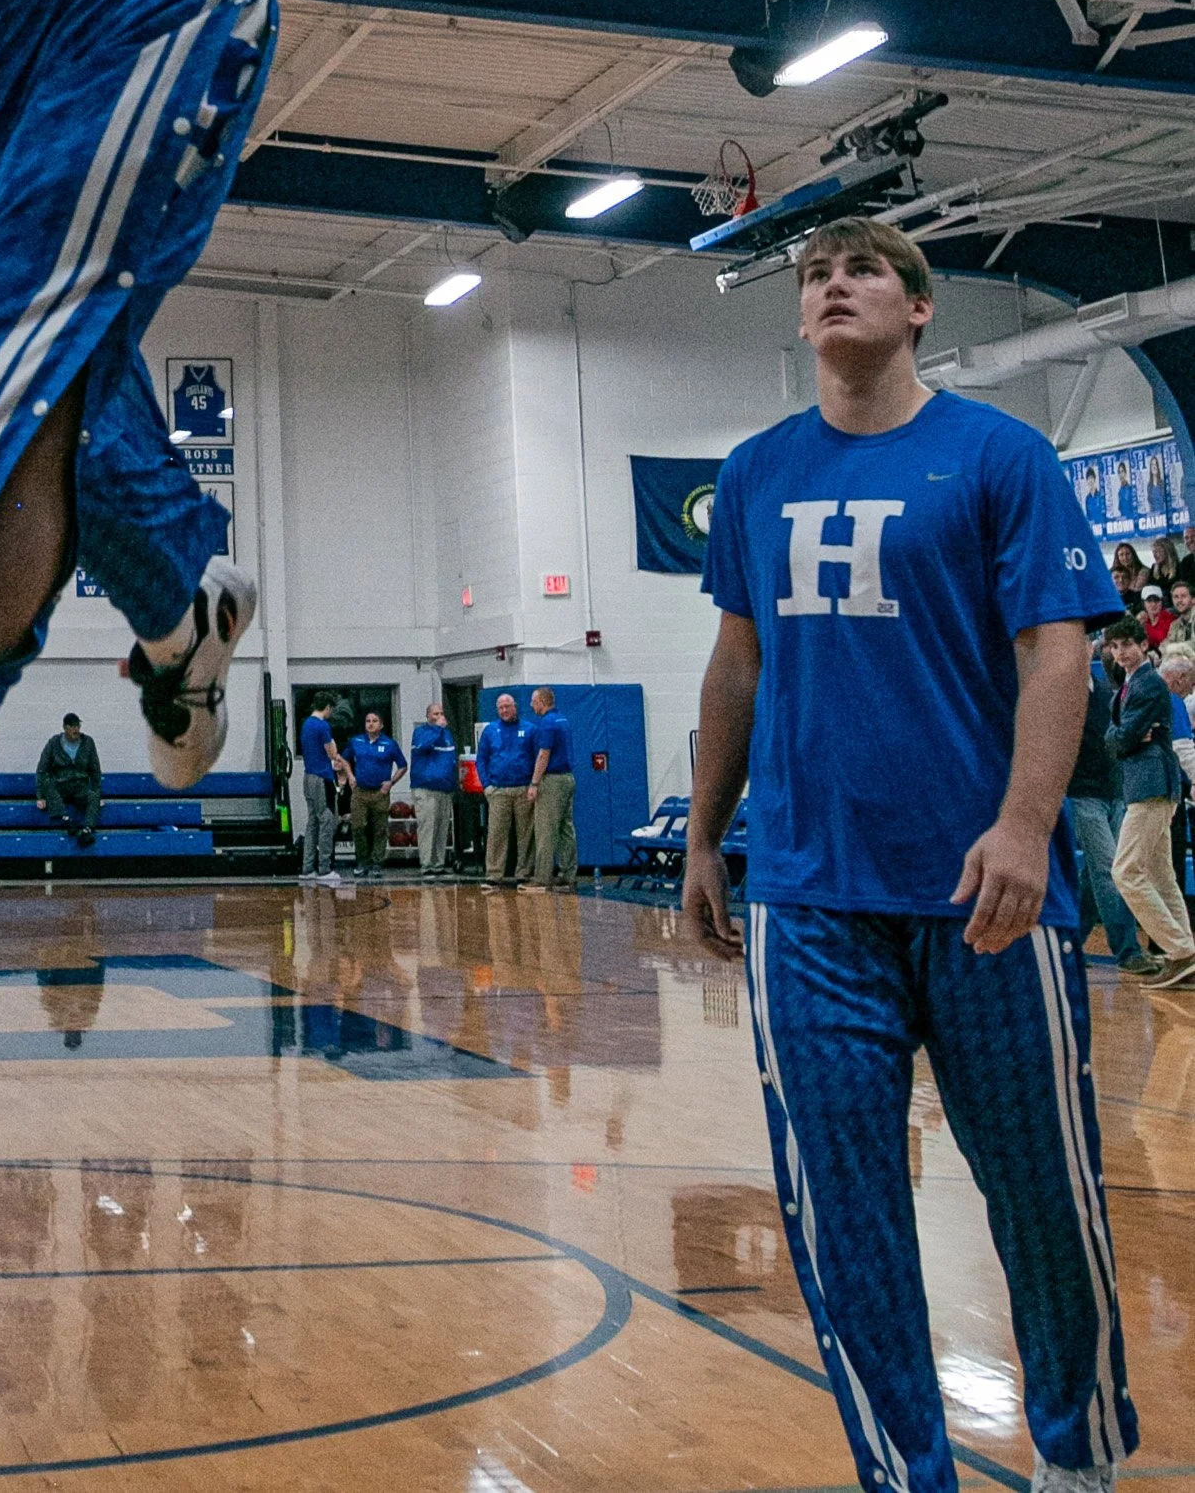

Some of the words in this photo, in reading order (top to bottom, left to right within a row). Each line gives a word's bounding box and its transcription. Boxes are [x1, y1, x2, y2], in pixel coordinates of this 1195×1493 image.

[191, 395, 207, 410] 45
[185, 449, 218, 460] ROSS
[188, 463, 233, 474] LTNER
[777, 499, 906, 618] H
